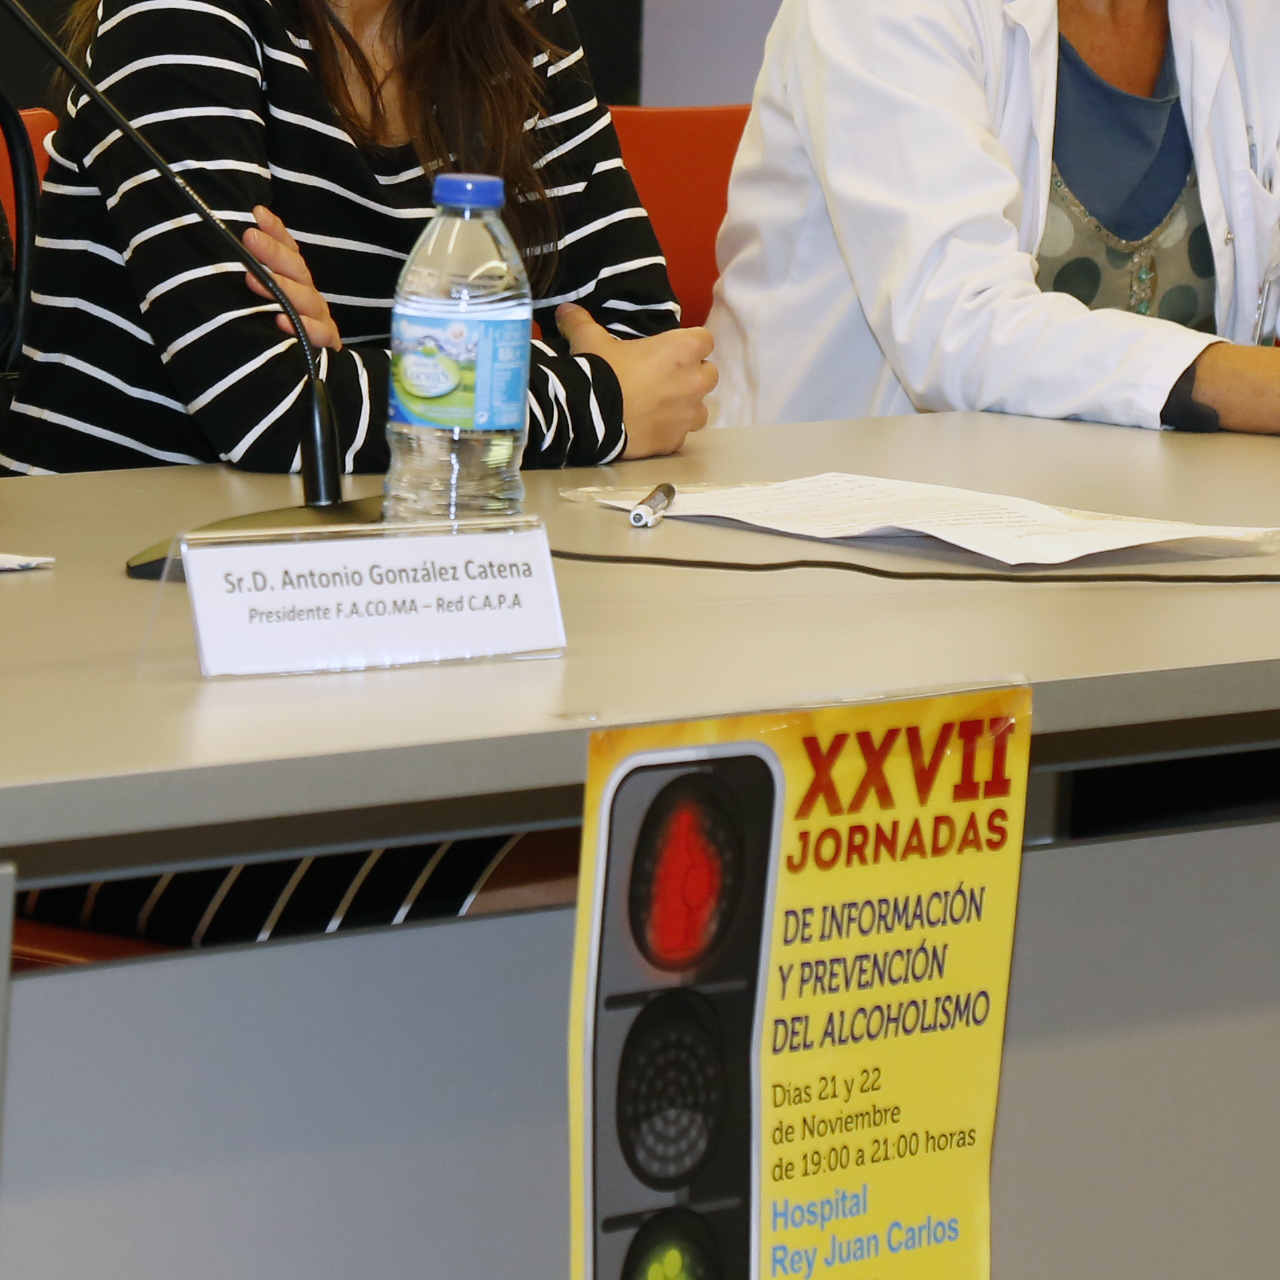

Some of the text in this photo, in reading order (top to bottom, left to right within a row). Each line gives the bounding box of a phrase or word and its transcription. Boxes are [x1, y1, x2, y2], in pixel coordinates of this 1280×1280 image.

[224, 558, 533, 594] Sr.D. Antonio González Catena
[248, 596, 331, 625] Presidente
[436, 594, 464, 614] Red
[468, 593, 522, 613] C.A.P.A
[795, 716, 1016, 820] XXVII
[786, 808, 1009, 875] JORNADAS
[784, 881, 986, 946] DE INFORMACIÓN
[778, 939, 948, 1001] Y PREVENCIÓN
[772, 990, 990, 1055] DEL ALCOHOLISMO
[772, 1068, 882, 1108] Días 21 y 22
[772, 1104, 901, 1145] de Noviembre
[772, 1128, 976, 1182] de 19:00 a 21:00 horas
[772, 1185, 868, 1232] Hospital
[772, 1216, 959, 1280] Rey Juan Carlos
